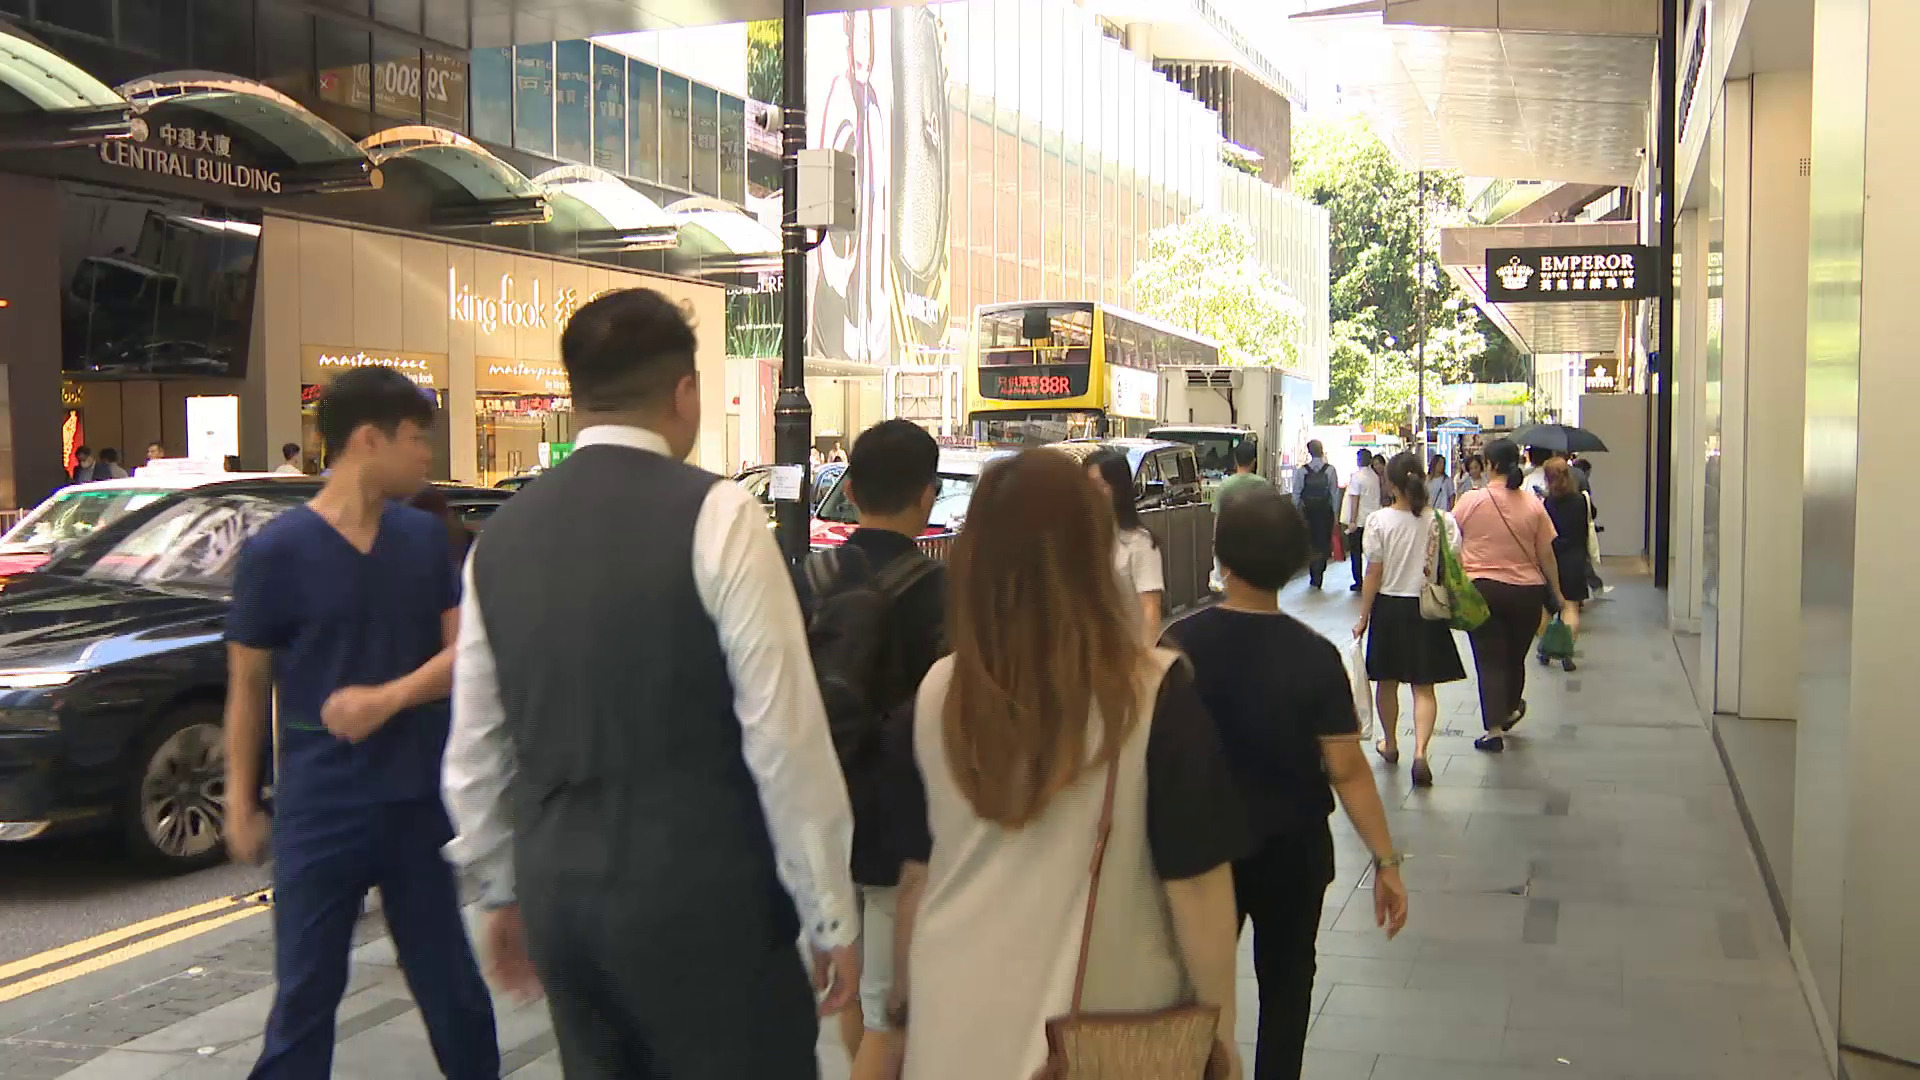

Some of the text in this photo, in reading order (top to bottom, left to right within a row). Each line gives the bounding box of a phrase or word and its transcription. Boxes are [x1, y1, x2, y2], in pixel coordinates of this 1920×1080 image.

[159, 122, 232, 158] 中建大廈
[100, 140, 282, 195] CENTRAL BUILDING
[1540, 254, 1634, 271] EMPEROR
[449, 265, 497, 336] king
[499, 273, 548, 328] fook
[319, 351, 429, 370] masterpiece
[1039, 376, 1070, 394] 88R
